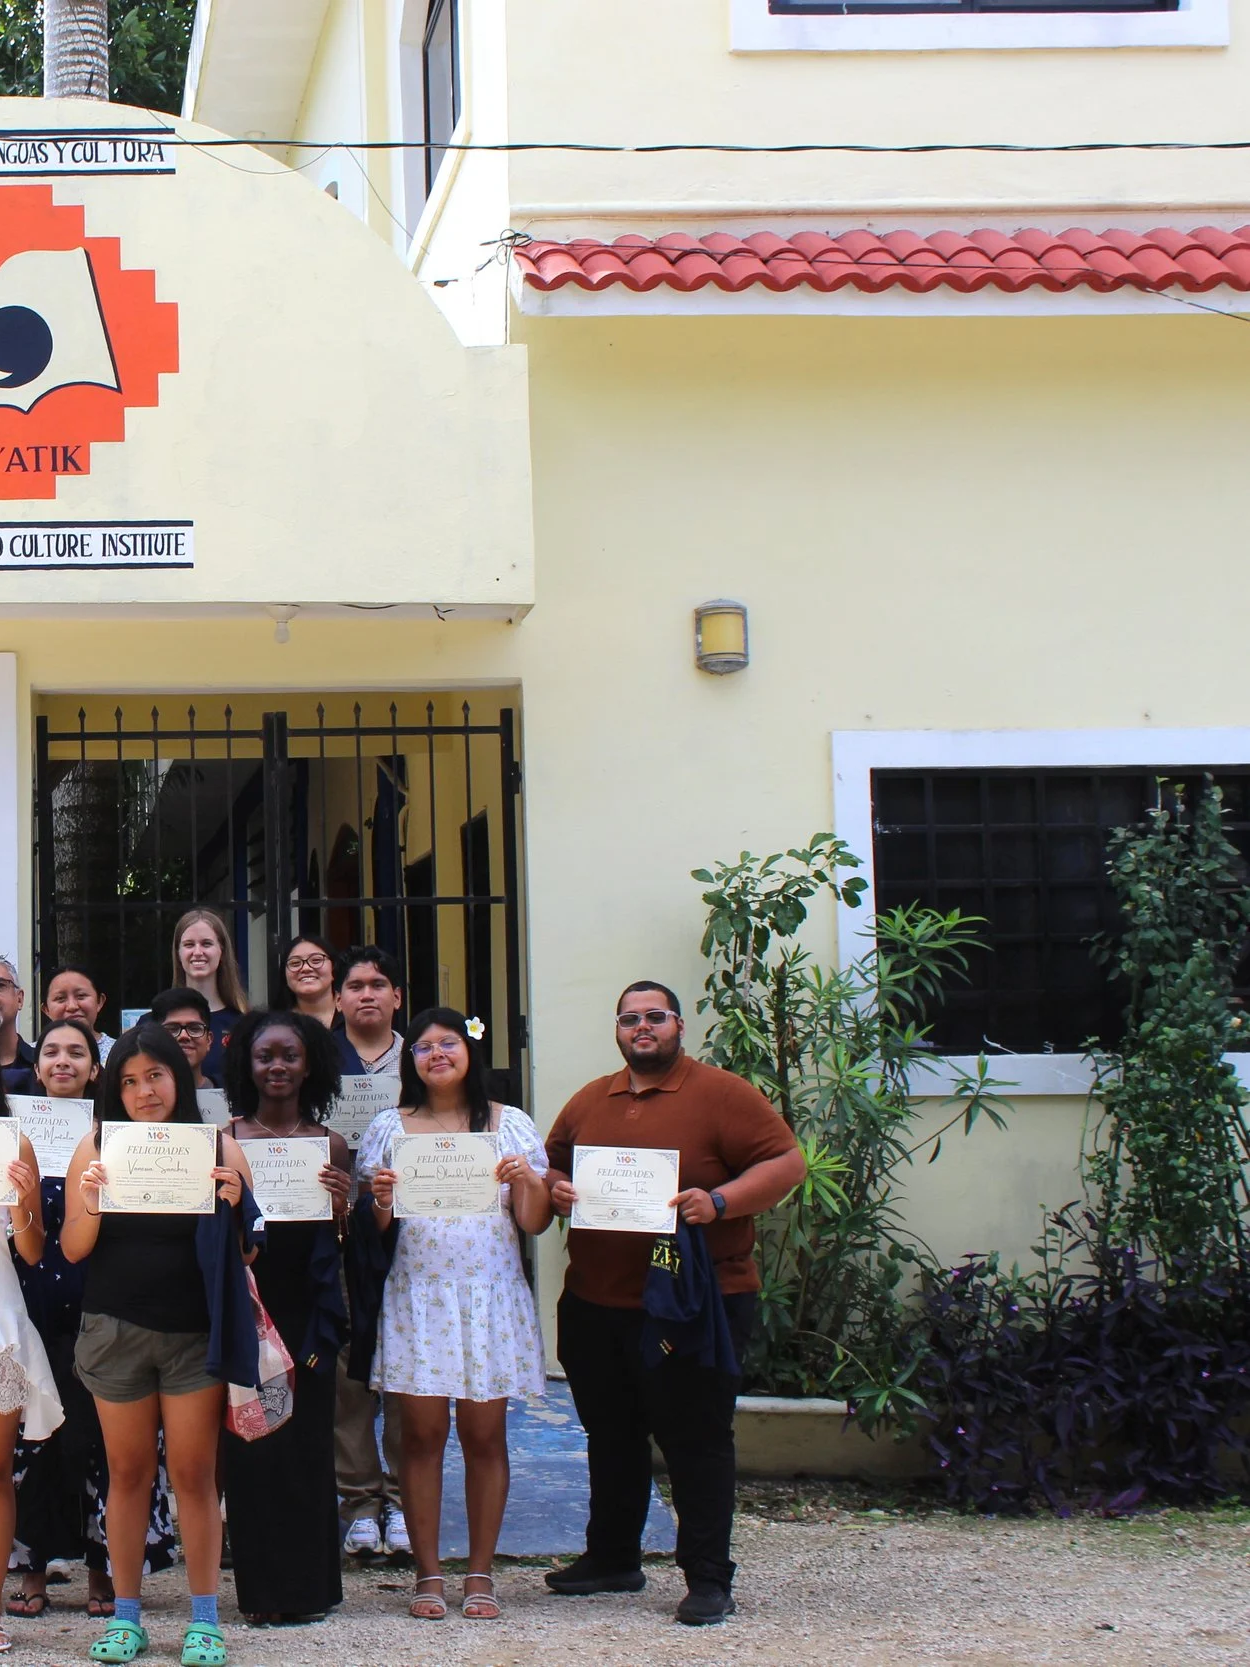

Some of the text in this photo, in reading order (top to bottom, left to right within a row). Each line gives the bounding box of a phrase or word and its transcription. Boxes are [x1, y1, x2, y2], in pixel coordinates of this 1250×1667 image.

[52, 141, 68, 164] Y
[71, 140, 165, 163] CULTURA
[9, 534, 93, 558] CULTURE
[102, 533, 186, 557] INSTITUTE
[17, 1115, 70, 1126] ELICIDADES
[127, 1145, 190, 1155] FELICIDADES
[251, 1160, 307, 1168] FELICIDADES
[416, 1154, 476, 1164] FELICIDADES
[597, 1168, 655, 1178] FELICIDADES
